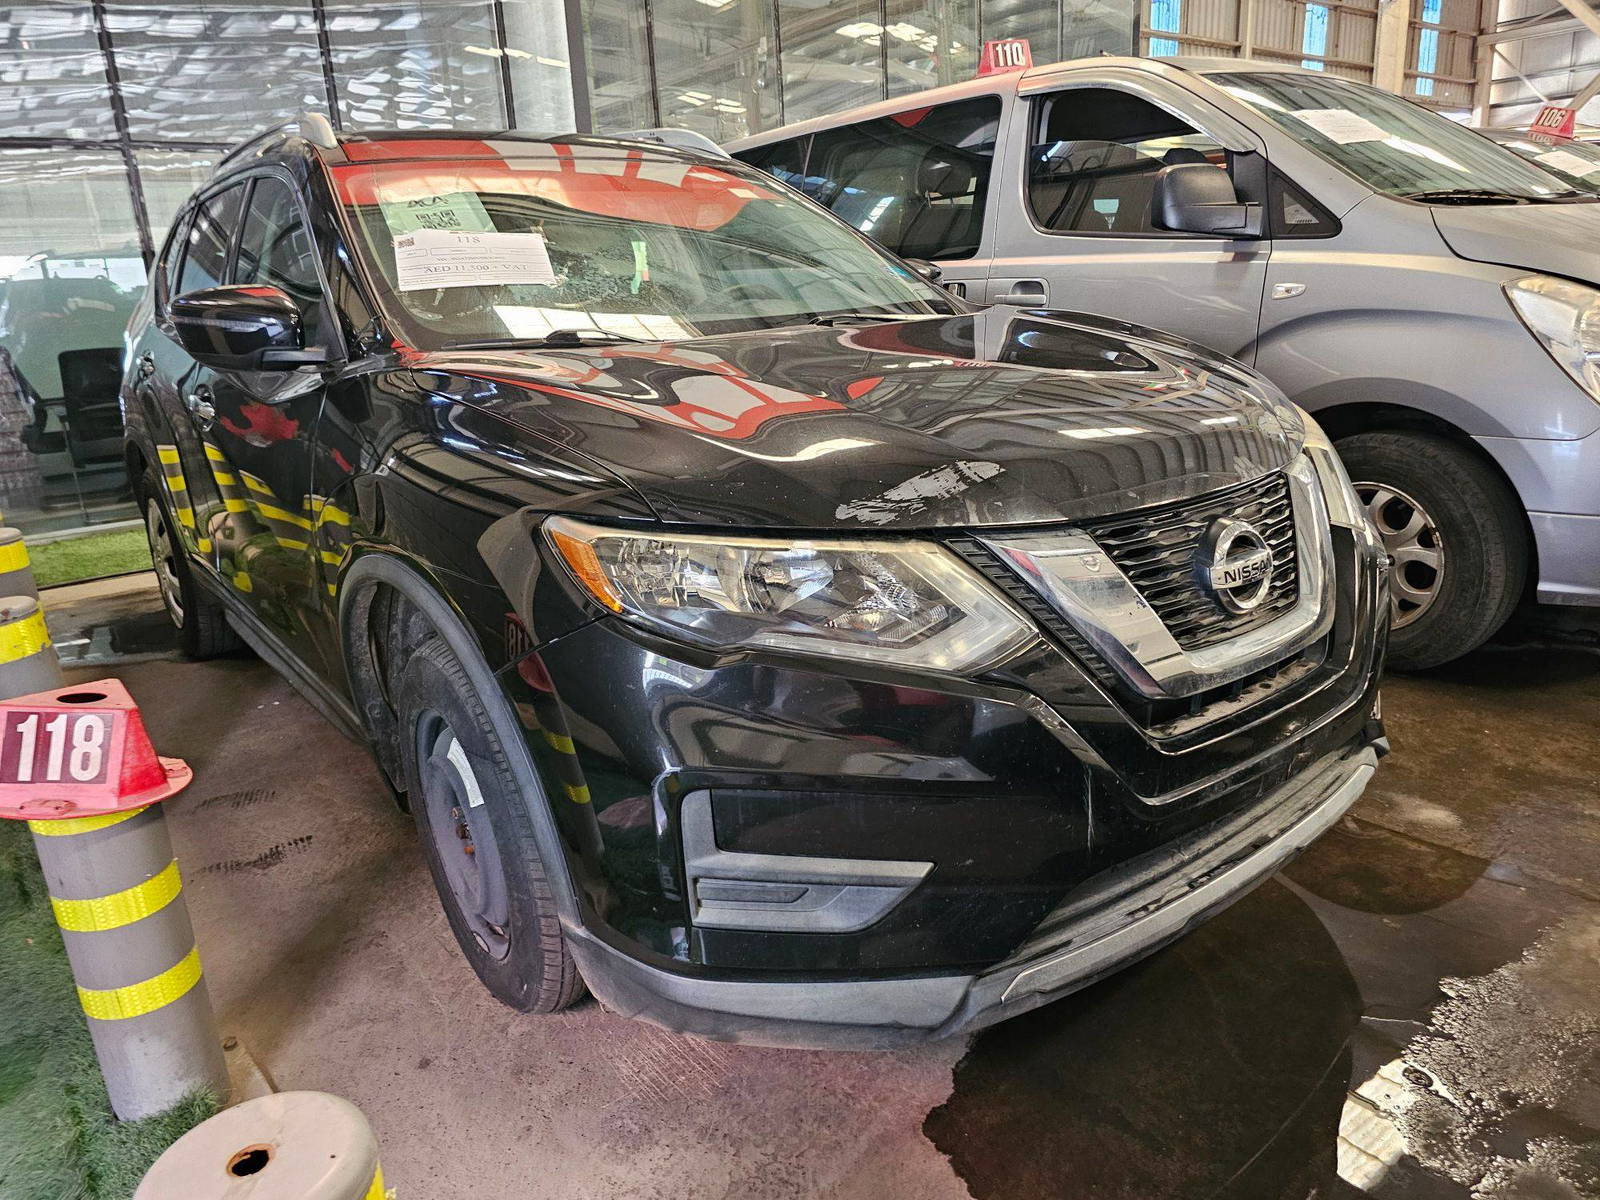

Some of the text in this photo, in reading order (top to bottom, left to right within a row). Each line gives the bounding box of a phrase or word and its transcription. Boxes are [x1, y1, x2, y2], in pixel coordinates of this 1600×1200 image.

[995, 42, 1026, 67] 110
[1537, 107, 1565, 128] 106
[424, 265, 451, 273] AED
[16, 713, 105, 782] 118
